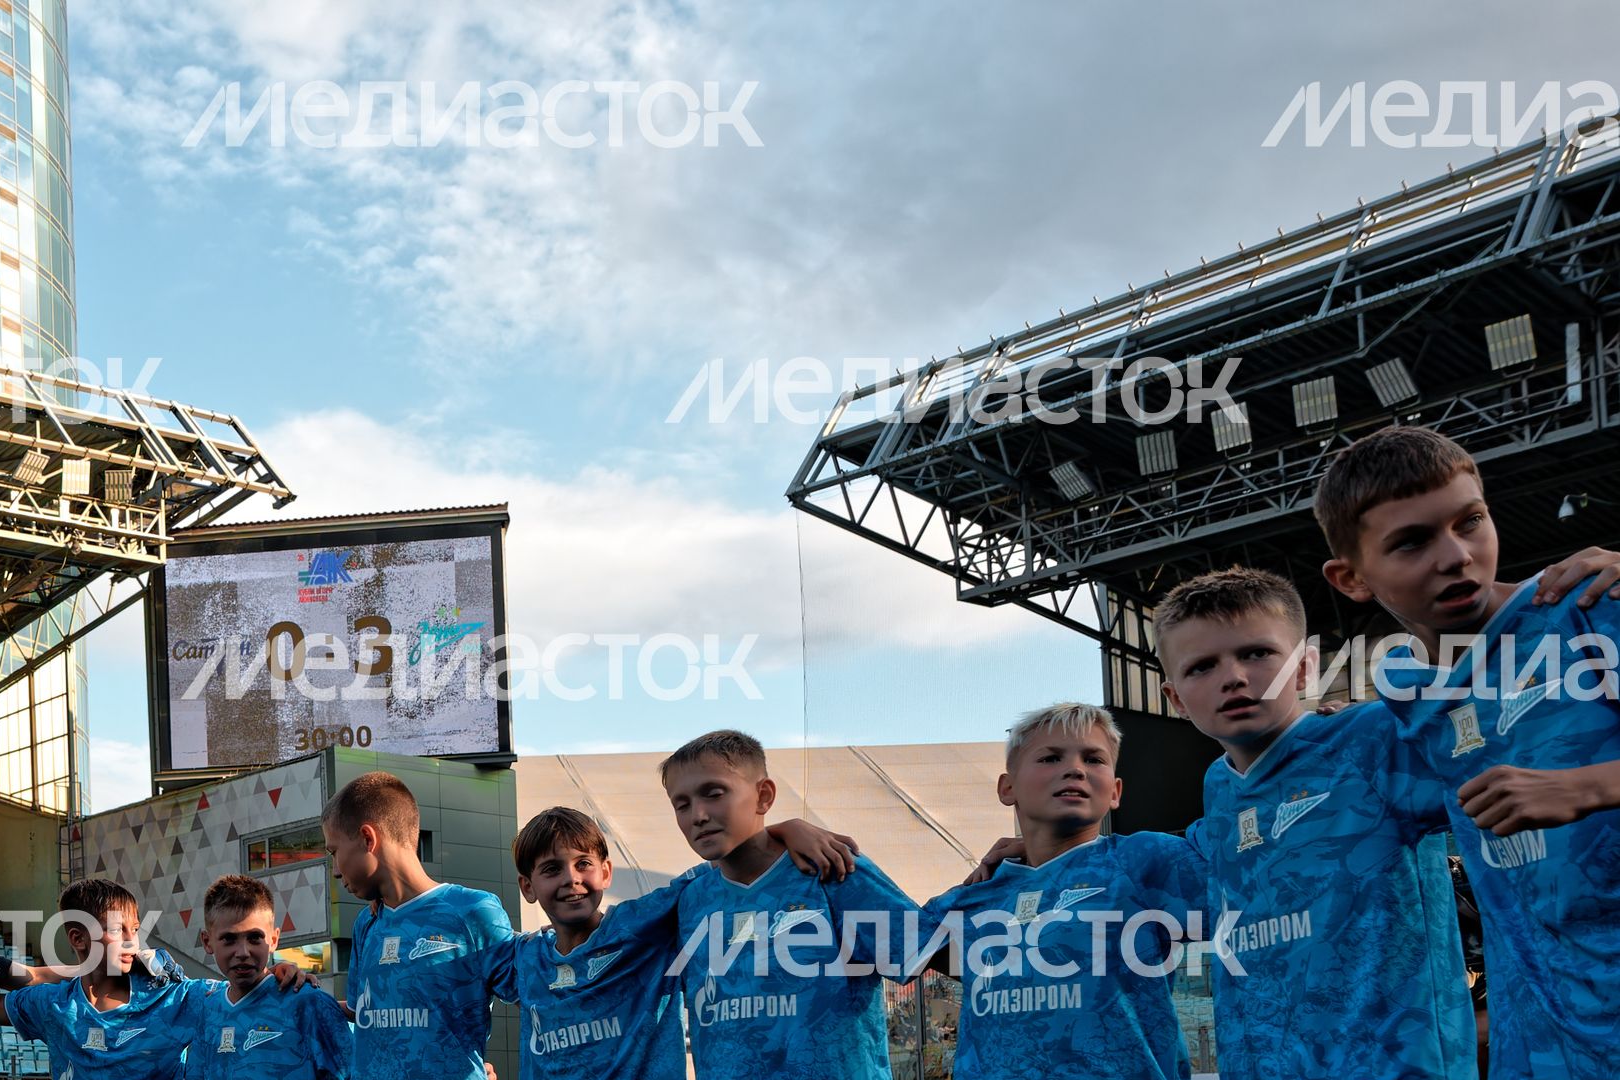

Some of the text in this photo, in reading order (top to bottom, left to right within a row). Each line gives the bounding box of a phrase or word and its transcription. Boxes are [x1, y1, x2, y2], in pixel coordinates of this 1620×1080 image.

[294, 726, 372, 752] 30:00
[1229, 911, 1312, 955] ГАЗПРОМ
[714, 994, 797, 1023] ГАЗПРОМ
[992, 983, 1082, 1015] ГАЗПРОМ
[372, 1007, 429, 1029] ГАЗПРОМ
[543, 1016, 622, 1053] ГАЗПРОМ
